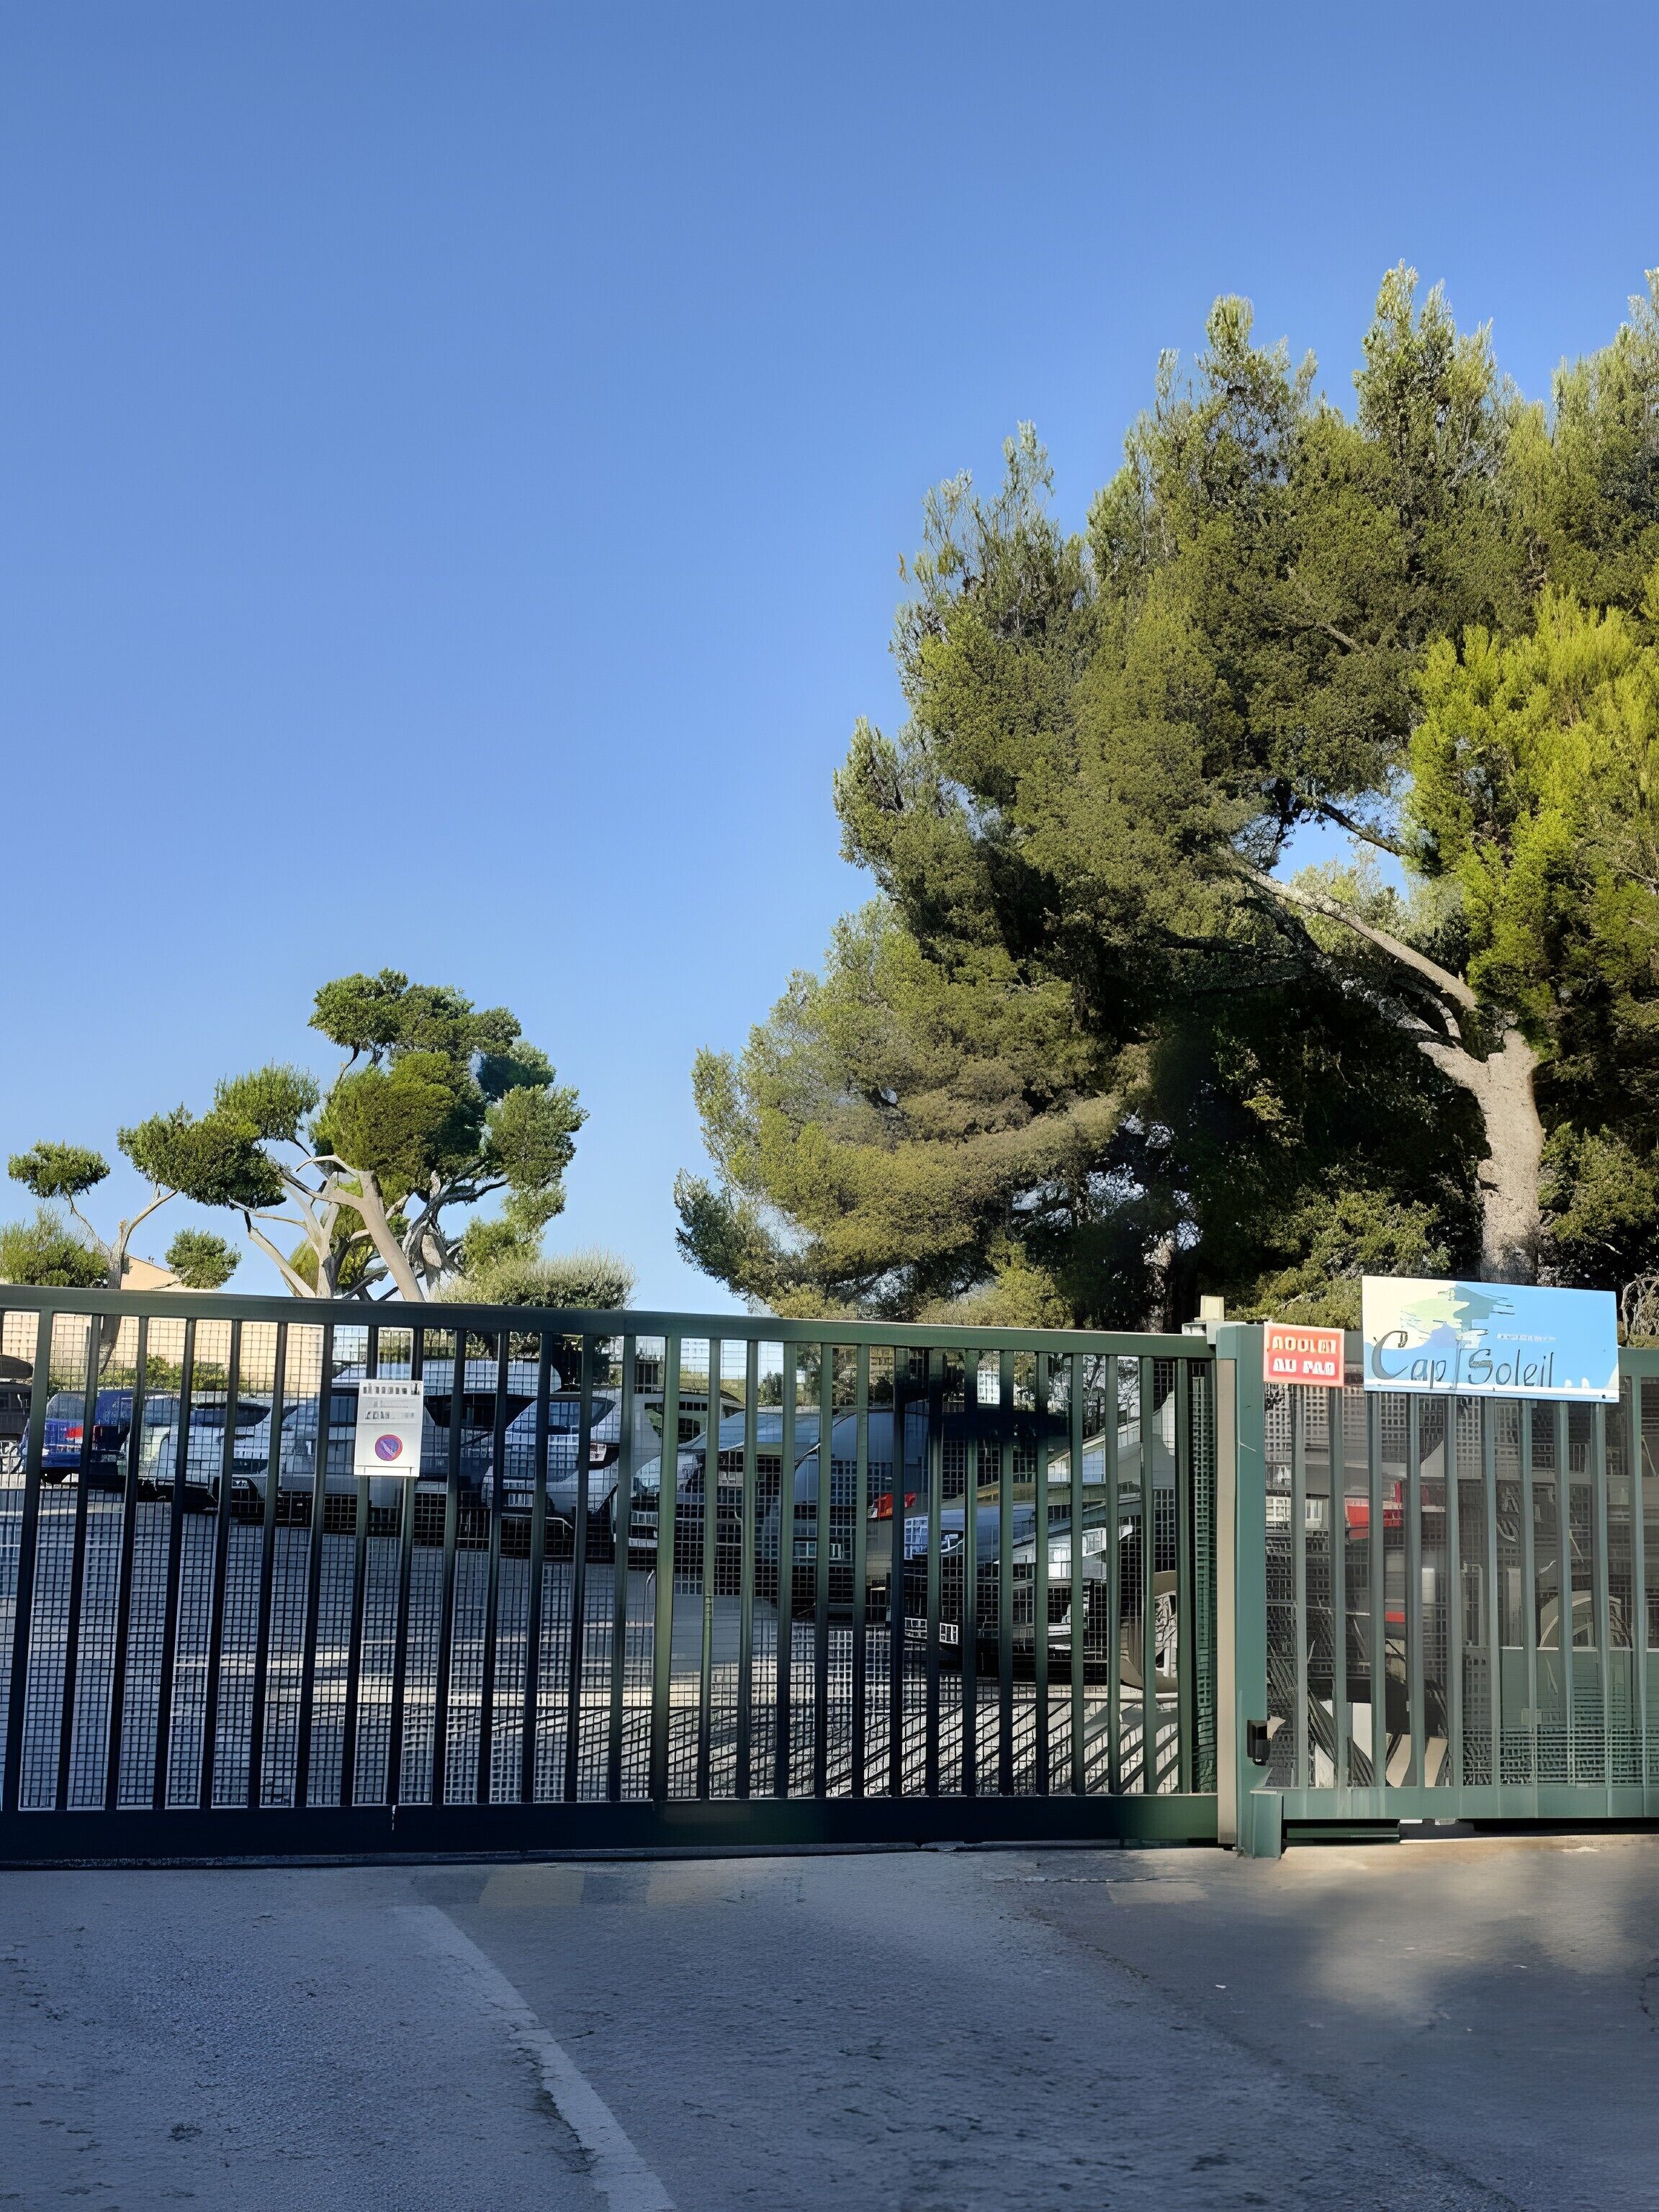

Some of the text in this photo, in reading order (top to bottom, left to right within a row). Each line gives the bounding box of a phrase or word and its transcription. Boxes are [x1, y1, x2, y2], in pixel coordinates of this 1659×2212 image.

[1273, 1358, 1297, 1373] AU
[1372, 1330, 1554, 1389] Cap Soleil
